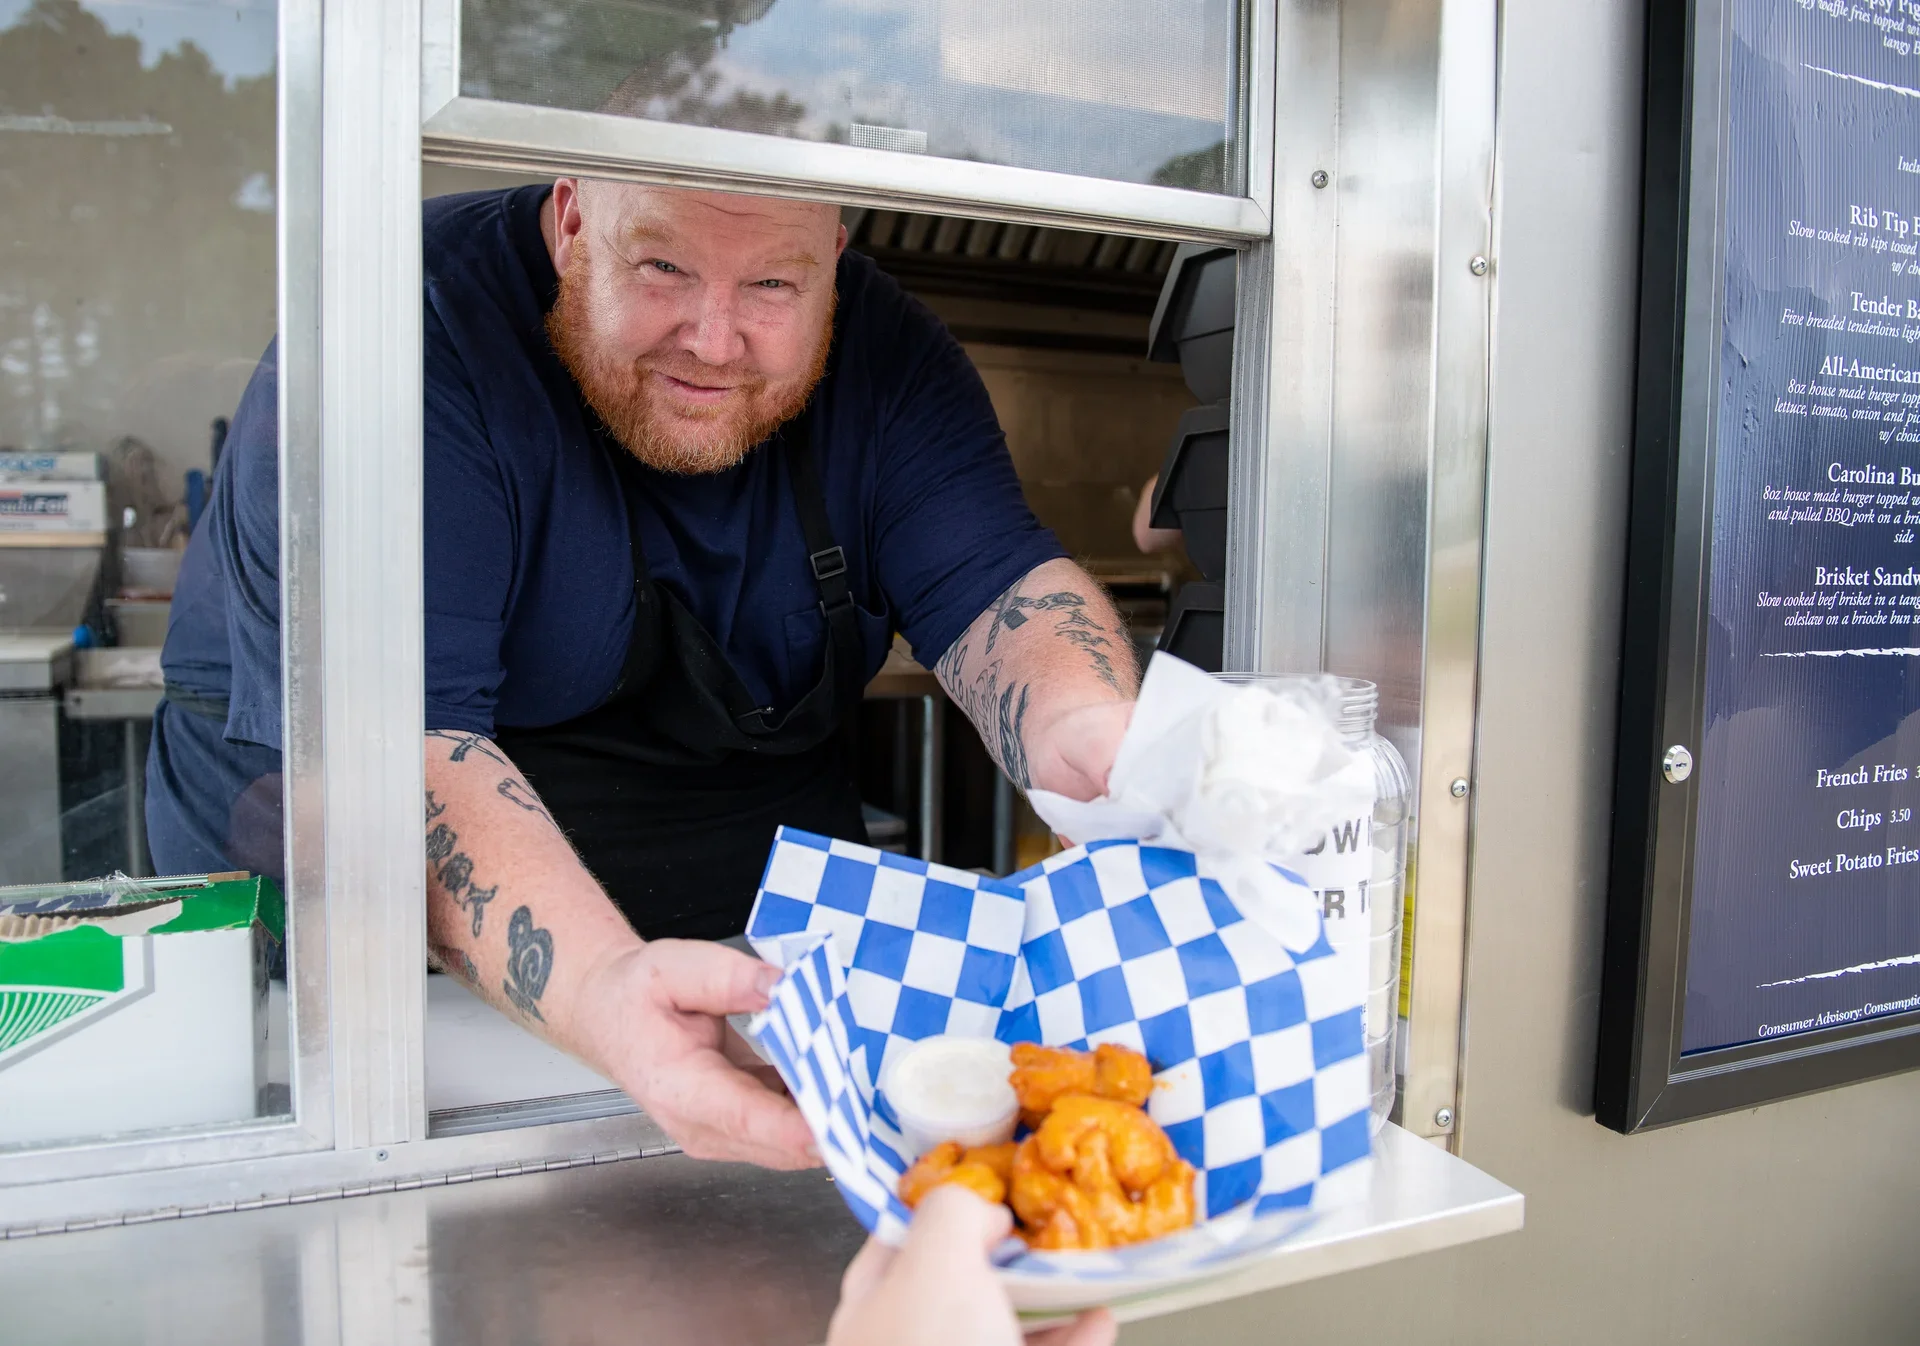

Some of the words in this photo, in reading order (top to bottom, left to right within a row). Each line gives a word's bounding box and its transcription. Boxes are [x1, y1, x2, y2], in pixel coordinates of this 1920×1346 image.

[1818, 0, 1848, 18] waffle
[1848, 4, 1871, 22] fries
[1873, 13, 1905, 32] topped
[1883, 35, 1911, 55] tangy
[1850, 204, 1879, 228] Rib
[1882, 210, 1909, 239] Tip
[1788, 220, 1815, 238] Slow
[1817, 227, 1851, 245] cooked
[1854, 232, 1869, 247] rib
[1871, 237, 1888, 254] tips
[1890, 240, 1917, 256] tossed
[1892, 258, 1908, 276] w/
[1850, 291, 1903, 317] Tender
[1781, 308, 1804, 326] Five
[1806, 312, 1846, 331] breaded
[1847, 319, 1900, 338] tenderloins
[1819, 355, 1920, 384] All-American
[1787, 379, 1806, 394] 8oz
[1808, 380, 1836, 397] house
[1838, 385, 1867, 400] made
[1868, 386, 1900, 406] burger
[1774, 398, 1808, 417] lettuce,
[1812, 405, 1848, 420] tomato,
[1852, 406, 1880, 421] onion
[1883, 409, 1904, 423] and
[1879, 427, 1896, 444] w/
[1827, 462, 1895, 485] Carolina
[1900, 466, 1920, 486] Bu
[1763, 485, 1781, 501] 8oz
[1783, 486, 1811, 501] house
[1813, 488, 1840, 503] made
[1842, 489, 1874, 507] burger
[1876, 492, 1910, 509] topped
[1768, 506, 1790, 521] and
[1790, 506, 1822, 525] pulled
[1824, 508, 1851, 526] BBQ
[1850, 509, 1875, 527] pork
[1877, 514, 1891, 524] on
[1893, 514, 1901, 524] a
[1893, 529, 1915, 544] side
[1815, 566, 1870, 586] Brisket
[1756, 591, 1782, 607] Slow
[1783, 591, 1816, 607] cooked
[1818, 591, 1840, 610] beef
[1839, 591, 1872, 606] brisket
[1874, 592, 1886, 606] in
[1888, 595, 1896, 606] a
[1899, 593, 1920, 610] tang
[1784, 611, 1824, 627] coleslaw
[1825, 614, 1839, 625] on
[1841, 614, 1849, 625] a
[1851, 610, 1888, 625] brioche
[1889, 610, 1910, 625] bun
[1816, 765, 1868, 788] French
[1872, 764, 1908, 783] Fries
[1836, 809, 1882, 832] Chips
[1890, 808, 1911, 823] 3.50
[1789, 858, 1832, 879] Sweet
[1835, 853, 1882, 872] Potato
[1886, 845, 1920, 866] Fries
[1758, 1018, 1814, 1038] Consumer
[1815, 1007, 1863, 1027] Advisory:
